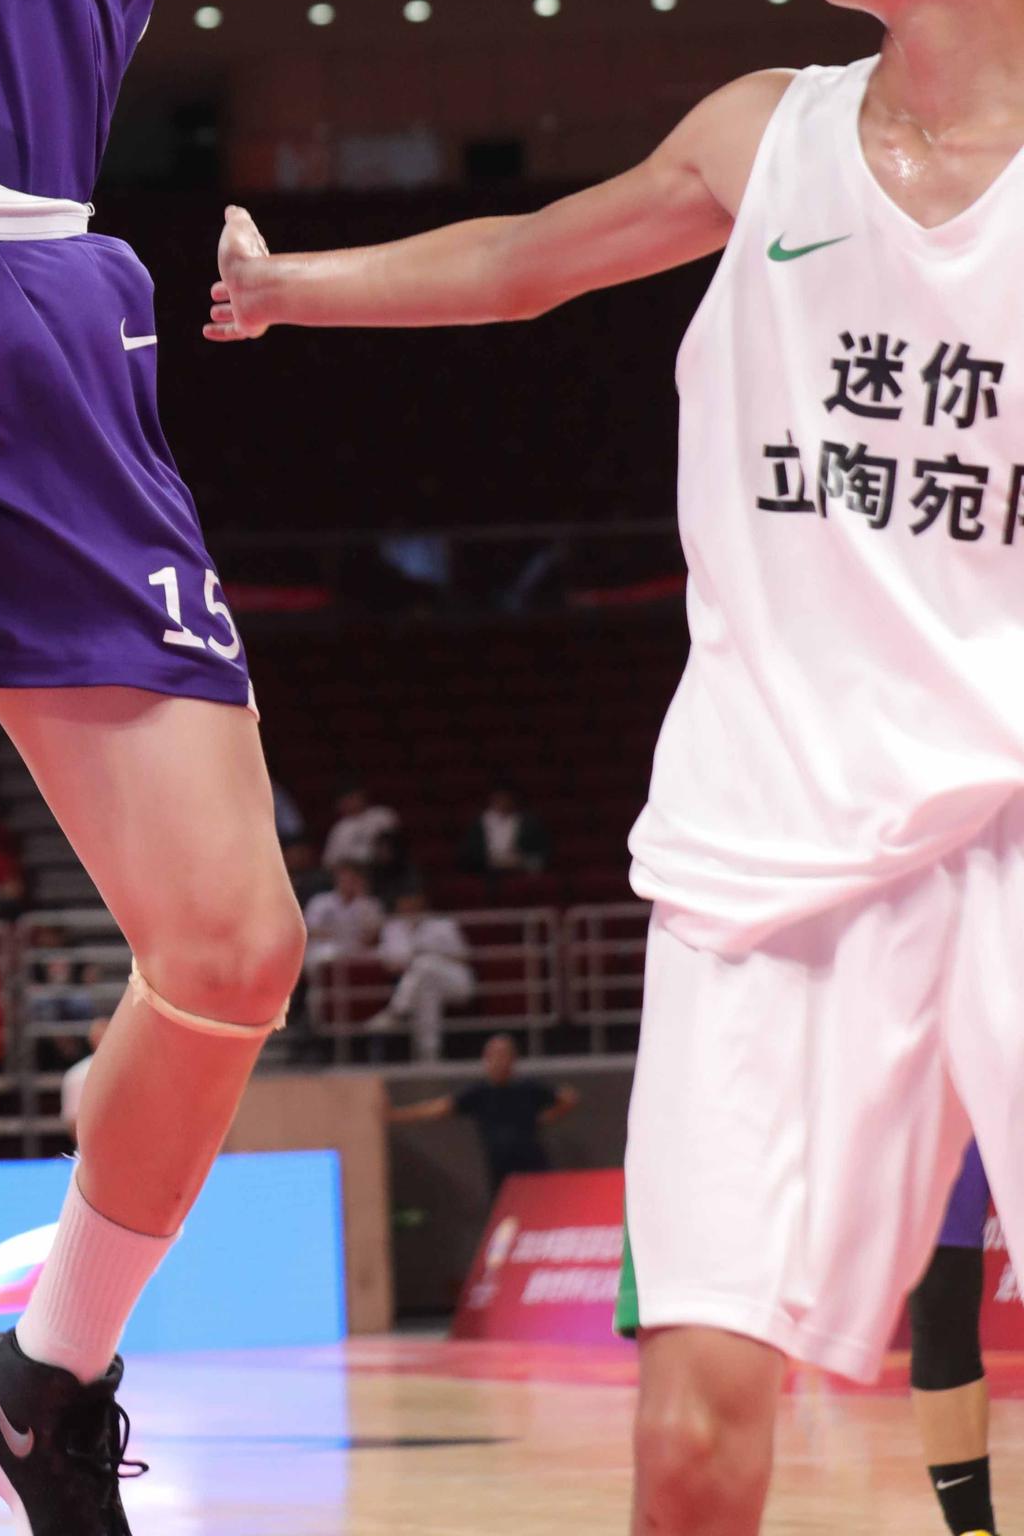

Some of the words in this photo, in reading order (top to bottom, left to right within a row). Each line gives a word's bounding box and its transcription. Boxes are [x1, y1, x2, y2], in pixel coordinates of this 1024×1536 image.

[822, 330, 1004, 430] 迷你
[756, 429, 1024, 546] 立陶宛
[148, 566, 240, 660] 15
